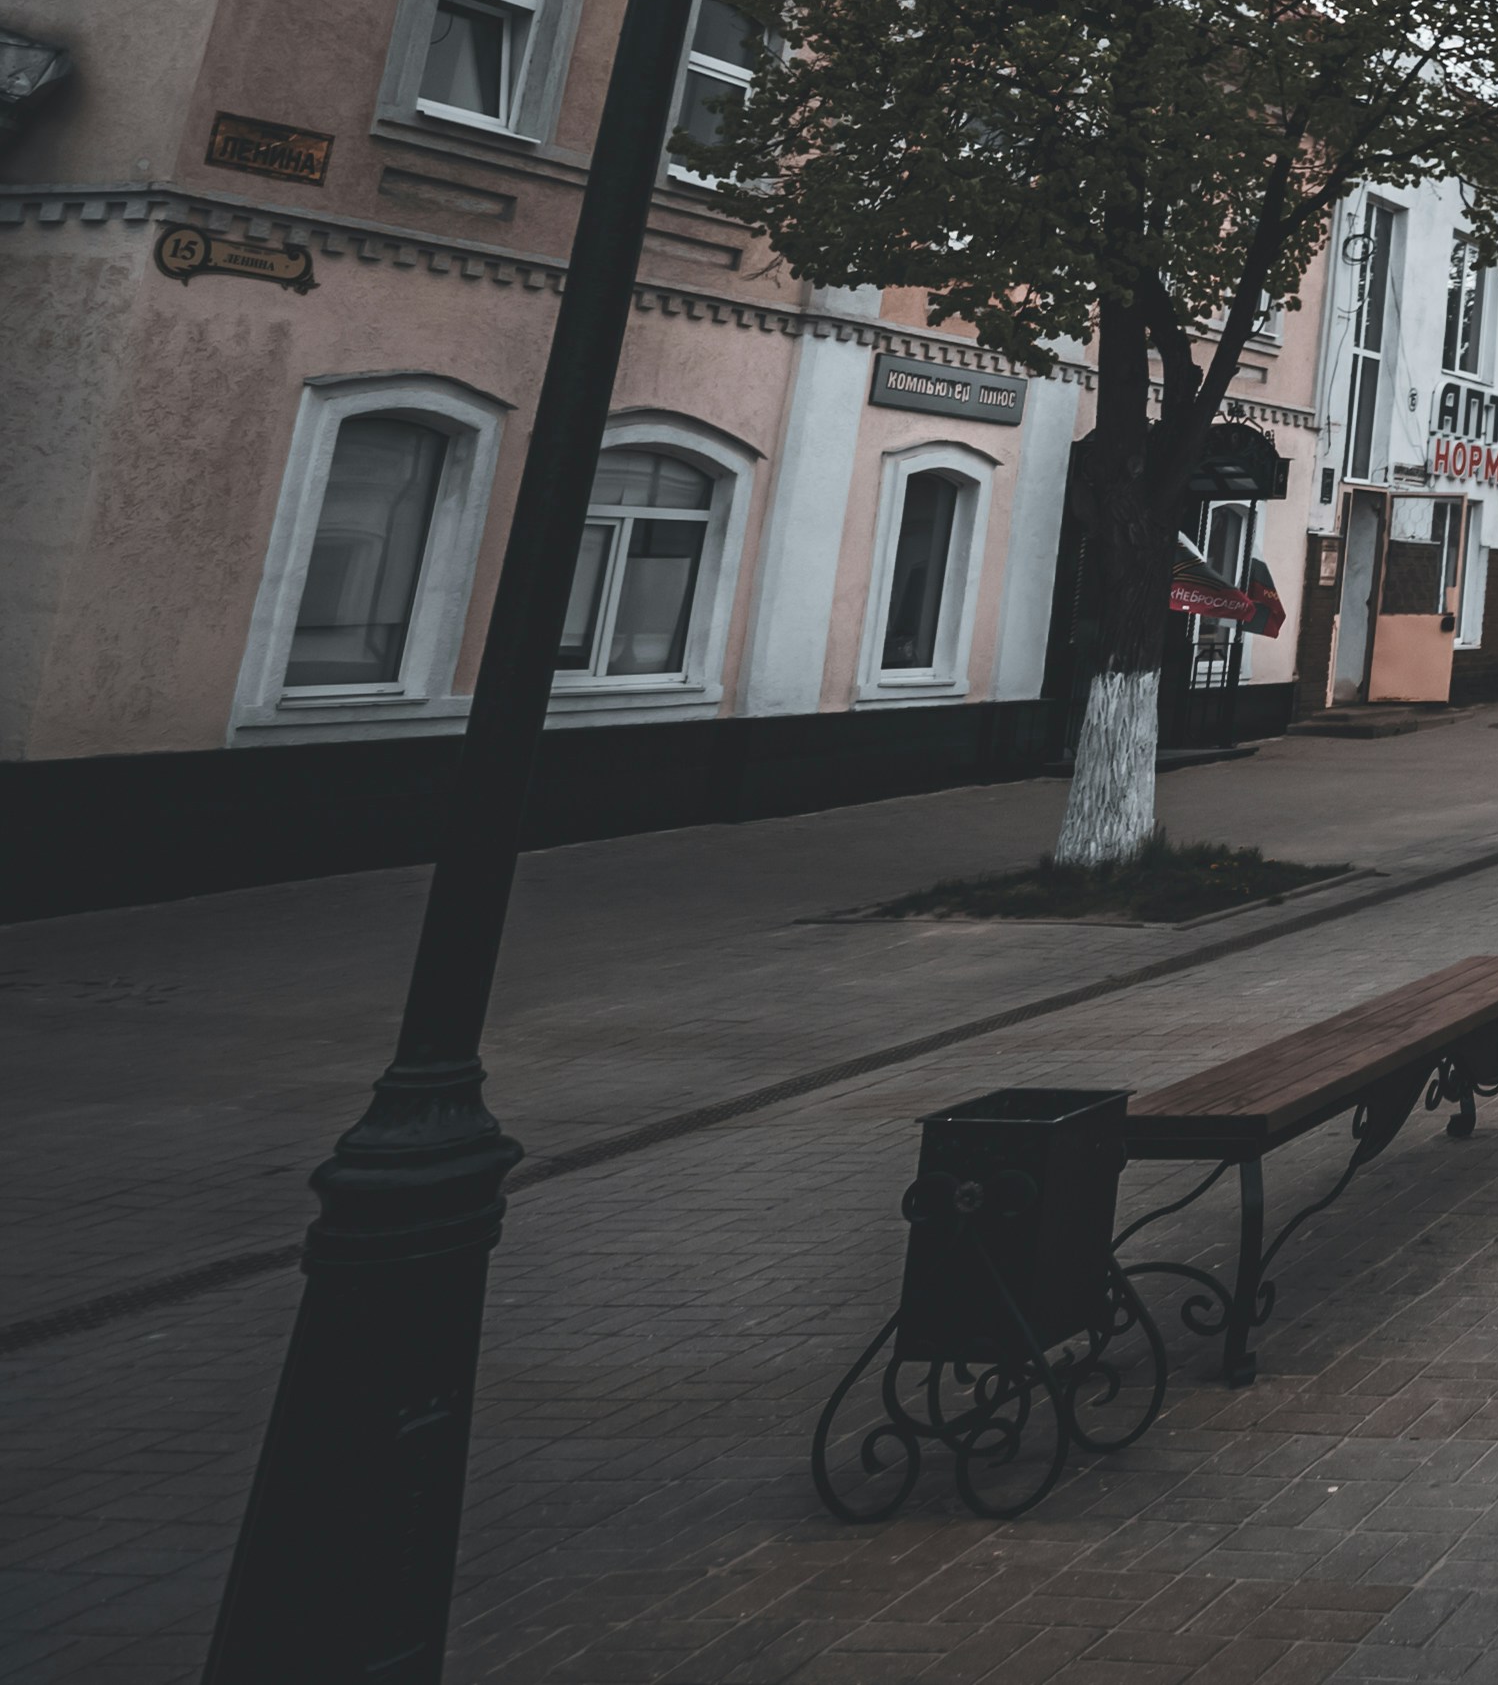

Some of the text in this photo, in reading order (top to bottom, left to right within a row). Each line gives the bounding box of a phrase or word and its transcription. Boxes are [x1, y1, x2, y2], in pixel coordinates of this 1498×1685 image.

[218, 134, 318, 176] ЛЕНИНА
[168, 237, 276, 272] 15 ЛЕНИНА
